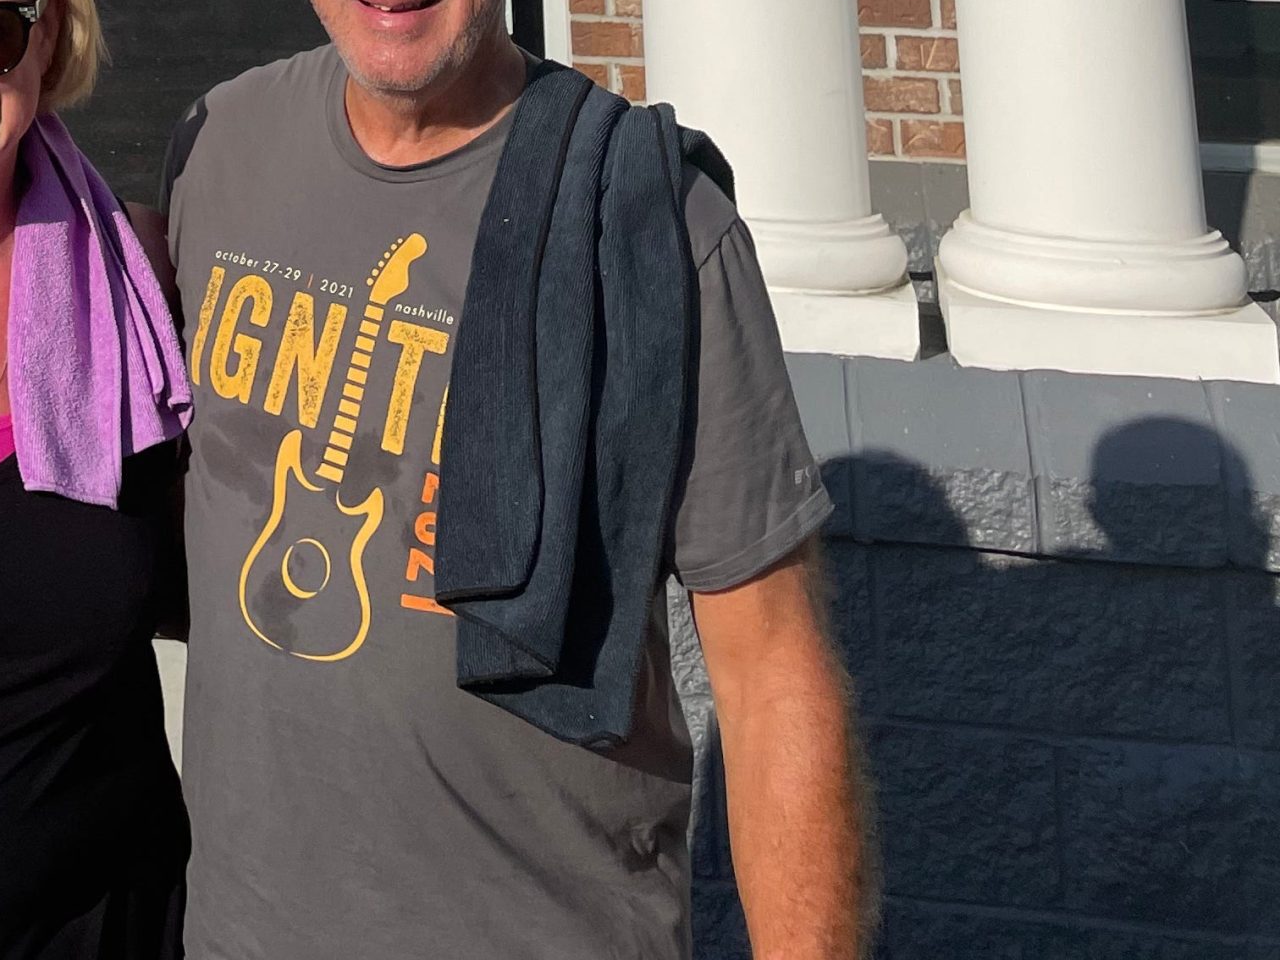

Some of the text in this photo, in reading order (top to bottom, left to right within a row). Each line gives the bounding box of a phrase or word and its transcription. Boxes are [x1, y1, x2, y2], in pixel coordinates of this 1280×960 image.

[215, 250, 259, 269] october
[262, 260, 302, 281] 27-29
[320, 278, 354, 299] 2021
[395, 302, 454, 326] nashville
[191, 266, 450, 464] IGNIT
